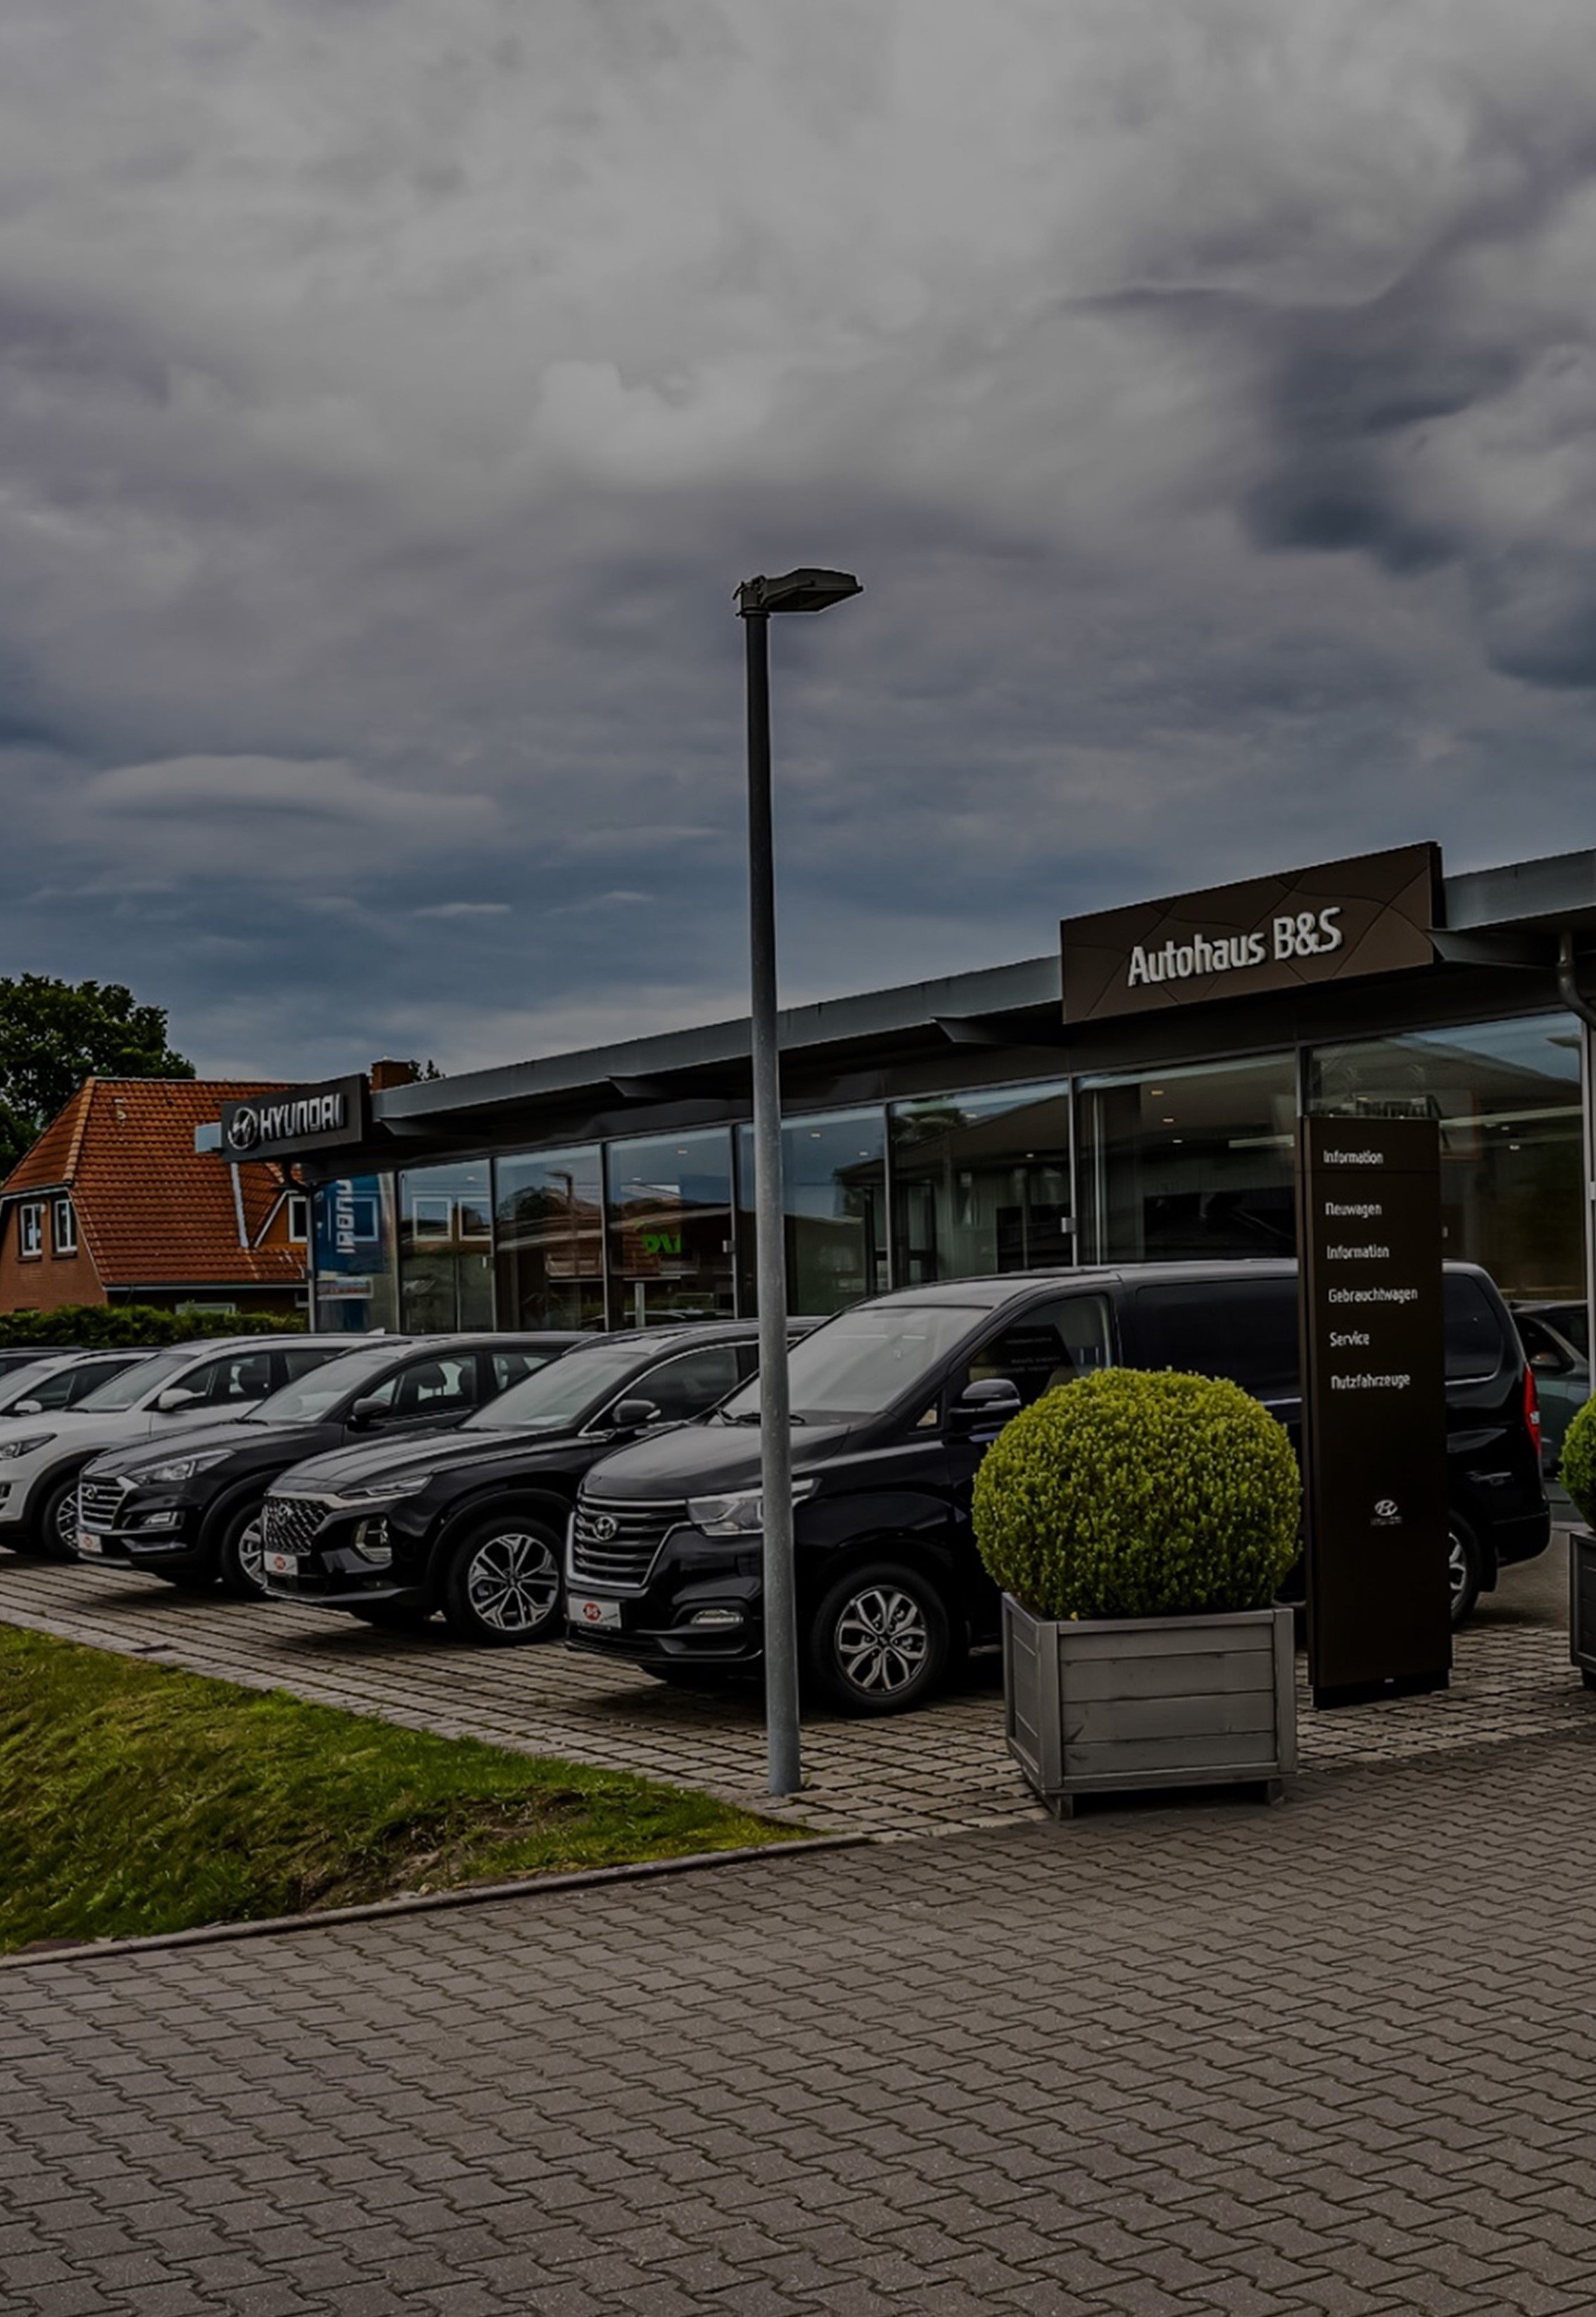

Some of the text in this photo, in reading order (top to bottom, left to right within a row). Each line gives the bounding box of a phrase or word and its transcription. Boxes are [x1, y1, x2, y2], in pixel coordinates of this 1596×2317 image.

[1127, 907, 1343, 987] Autohaus B&S
[260, 1092, 343, 1142] HYUNDAI
[1323, 1149, 1384, 1165] Information
[1324, 1201, 1383, 1218] Neuwagen
[1326, 1244, 1391, 1260] Information
[1328, 1287, 1419, 1304] Gebrauchtwagen
[1329, 1330, 1370, 1347] Service
[1330, 1373, 1411, 1389] Nutzfahrzeuge
